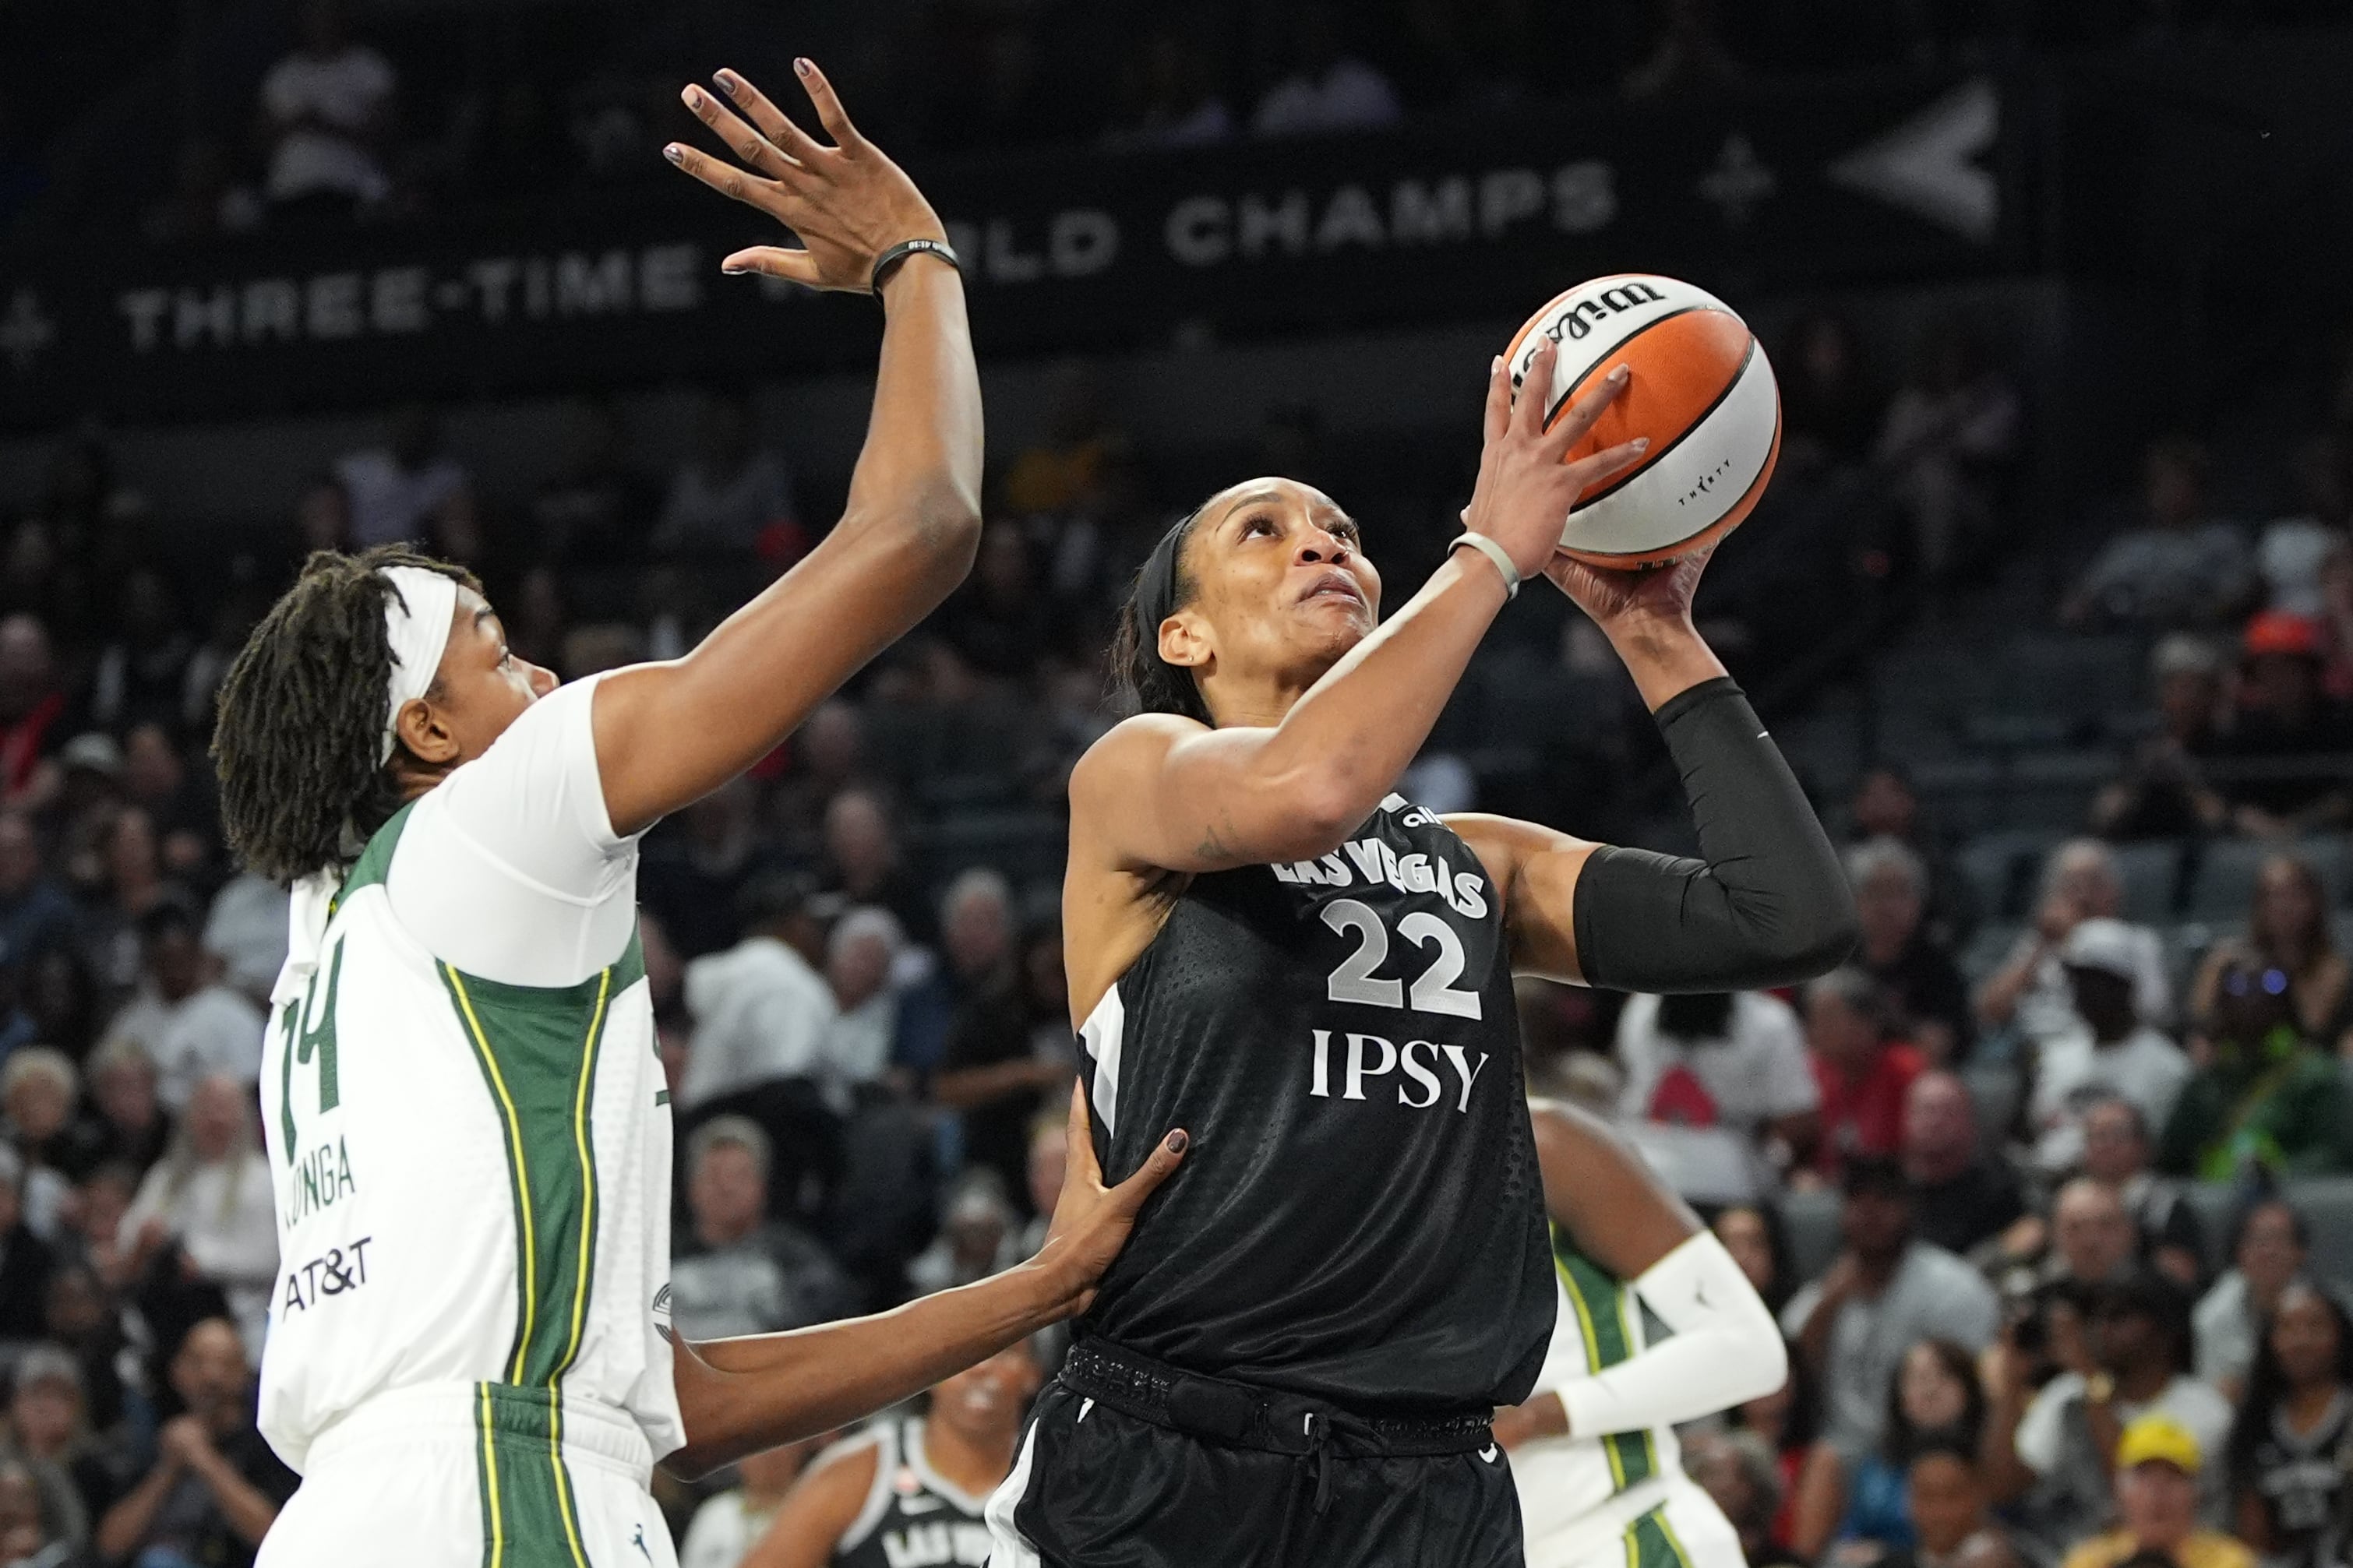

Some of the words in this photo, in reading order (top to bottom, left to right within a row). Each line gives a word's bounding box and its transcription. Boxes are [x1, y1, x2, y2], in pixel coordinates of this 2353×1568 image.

[118, 243, 703, 351] THREE-TIME
[1166, 160, 1618, 266] CHAMPS
[1320, 898, 1482, 1021] 22
[280, 929, 346, 1167] 14
[1309, 1029, 1489, 1113] IPSY
[284, 1133, 355, 1231] ONGA
[282, 1236, 372, 1324] AT&T
